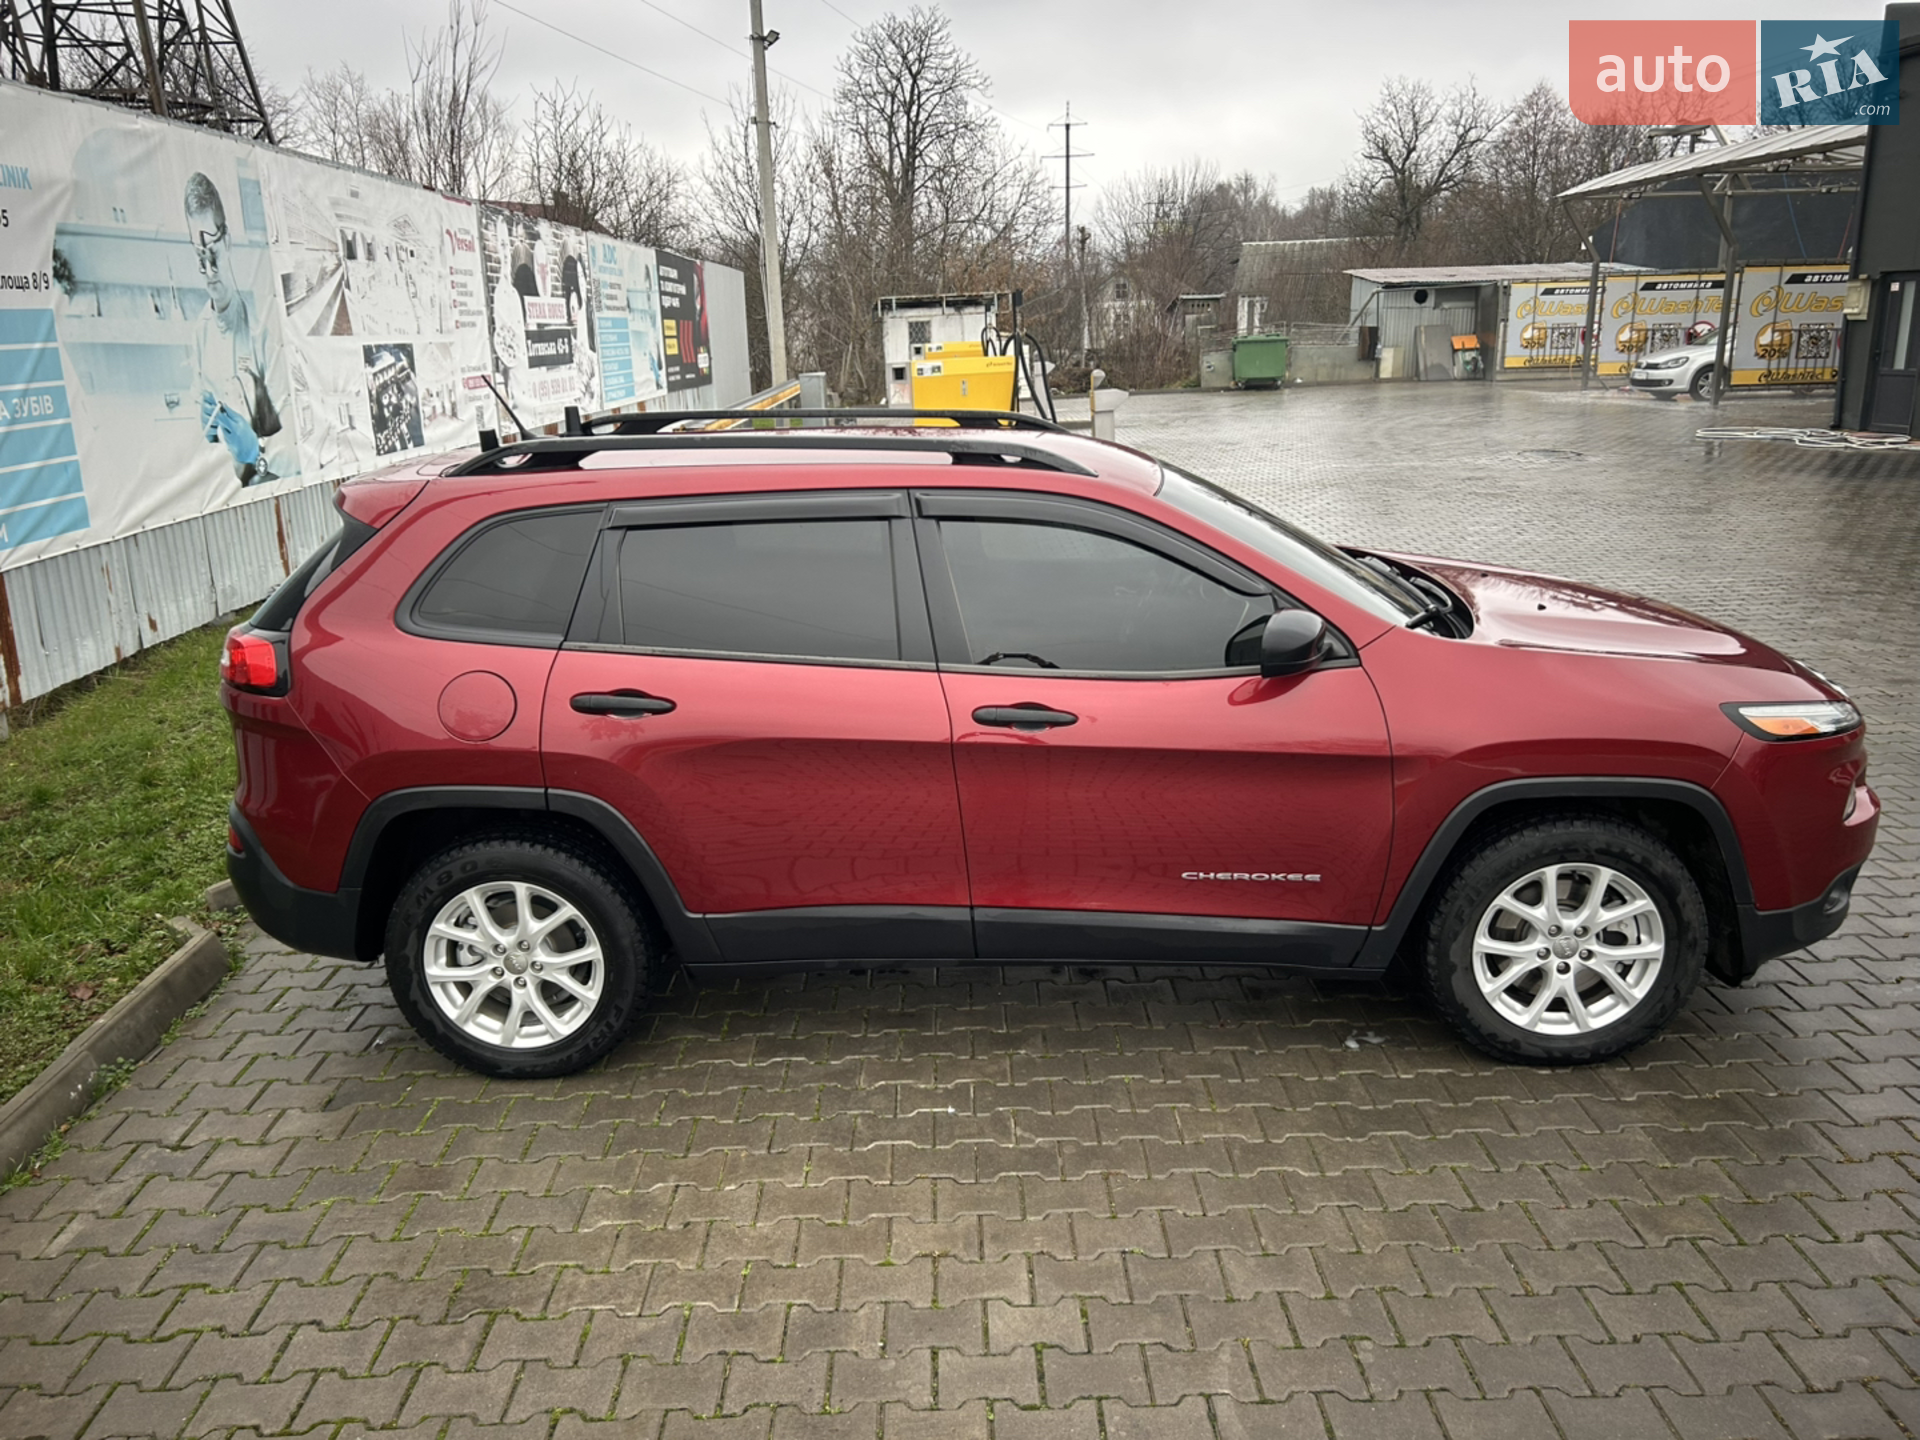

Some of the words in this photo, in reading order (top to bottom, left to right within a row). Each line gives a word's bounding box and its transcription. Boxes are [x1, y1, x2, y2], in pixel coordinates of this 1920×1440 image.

[0, 208, 9, 228] 5
[31, 270, 50, 293] 8/9
[1553, 287, 1592, 295] автоми
[12, 394, 54, 419] ЗУБІВ
[1181, 871, 1322, 883] CHEROKEE
